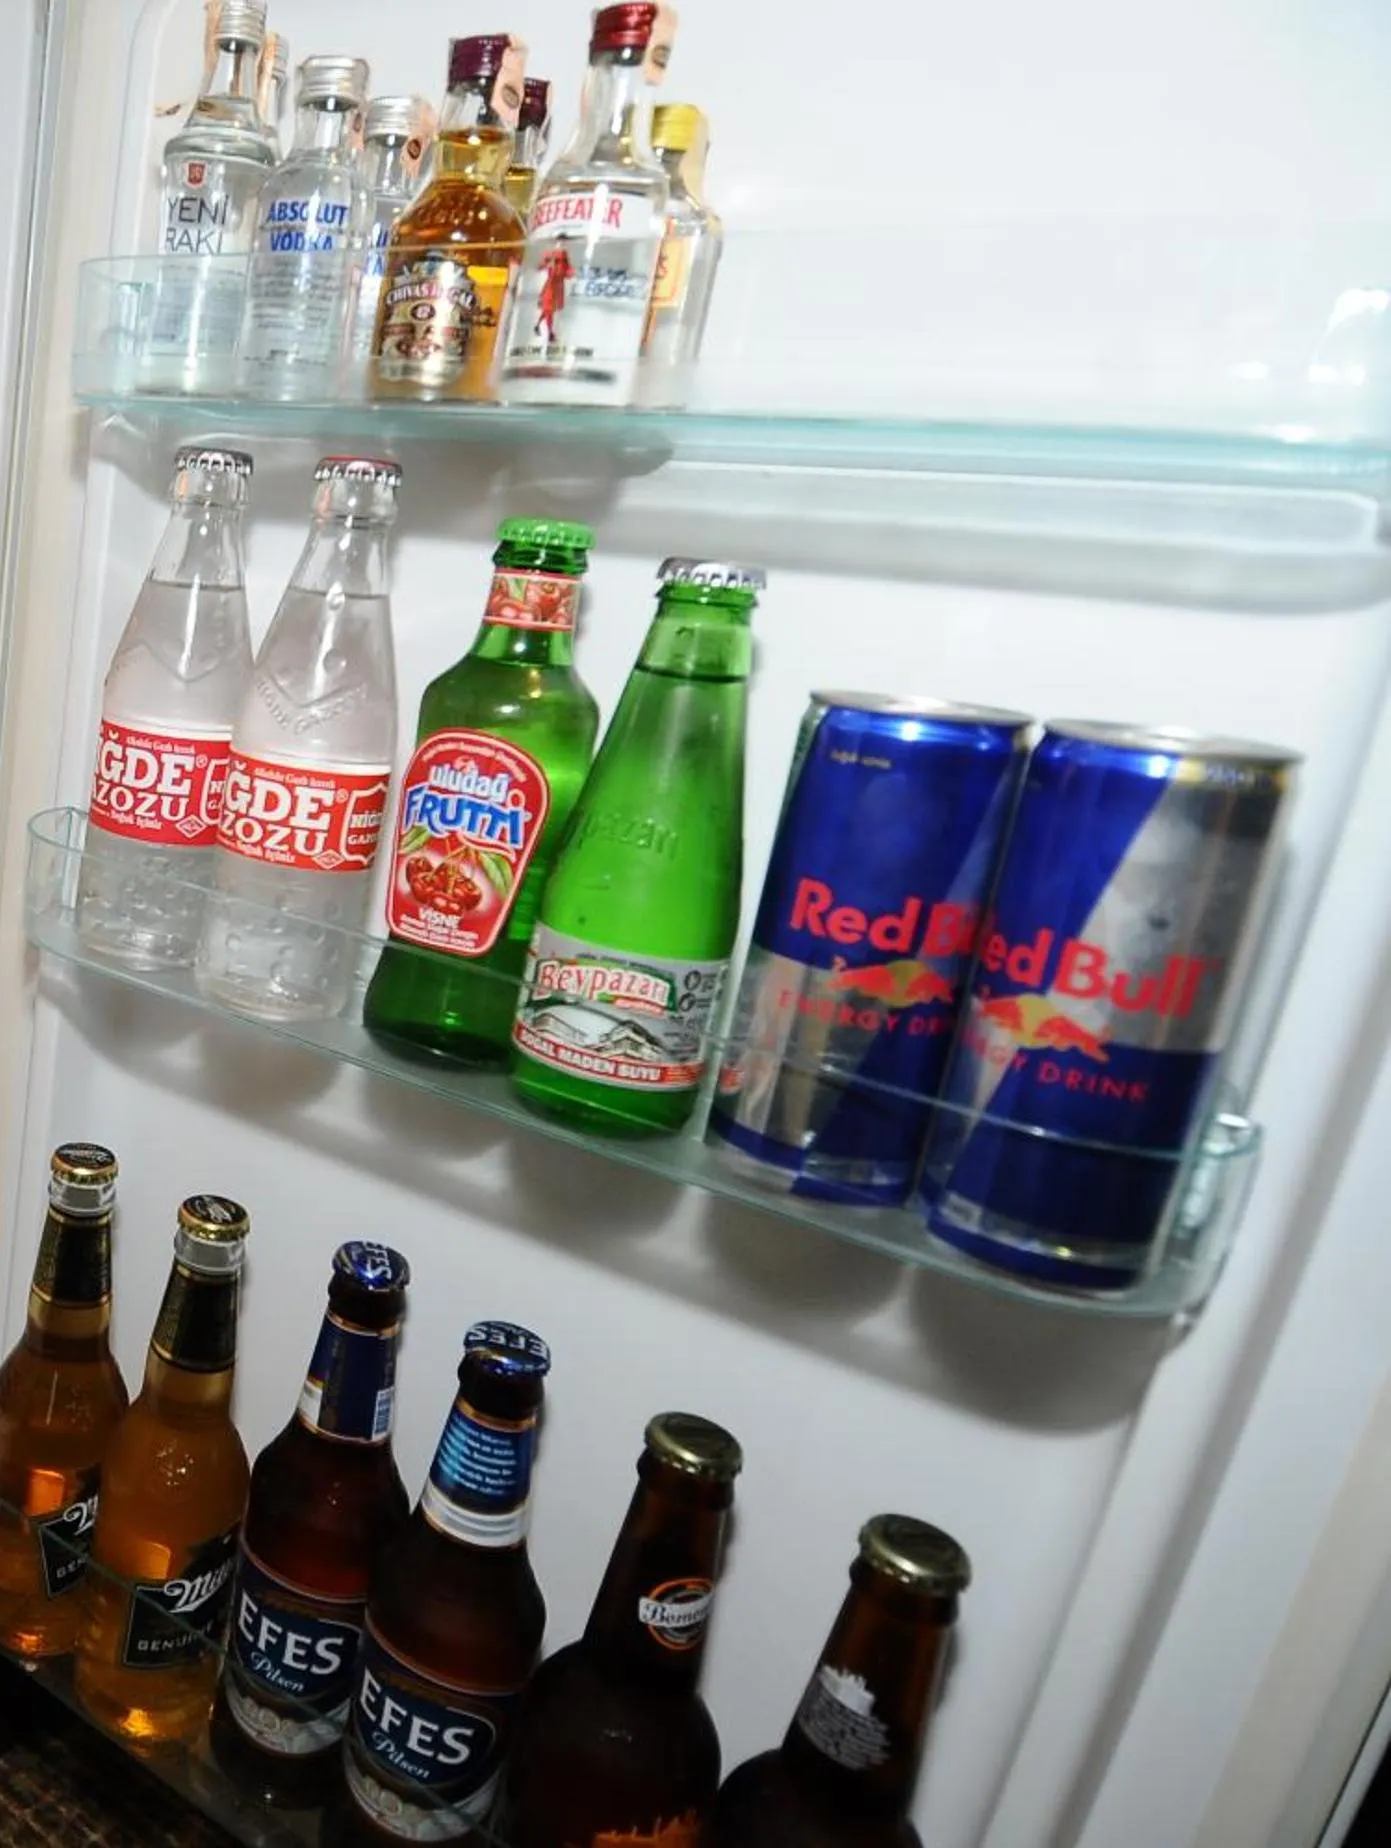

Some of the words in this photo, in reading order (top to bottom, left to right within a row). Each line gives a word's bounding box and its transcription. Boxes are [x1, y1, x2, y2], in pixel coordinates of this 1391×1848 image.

[99, 730, 195, 796] ĞDE
[226, 760, 335, 831] ĞDE
[95, 779, 189, 821] ZOZU
[221, 810, 329, 856] ZOZU
[790, 877, 923, 953] Red
[984, 927, 1054, 988] ed
[1055, 939, 1206, 1020] Bull
[1038, 1061, 1149, 1101] DRINK
[238, 1588, 345, 1676] EFES
[250, 1650, 305, 1693] Pilsen
[361, 1665, 475, 1766] EFES
[372, 1730, 430, 1780] Pilsen
